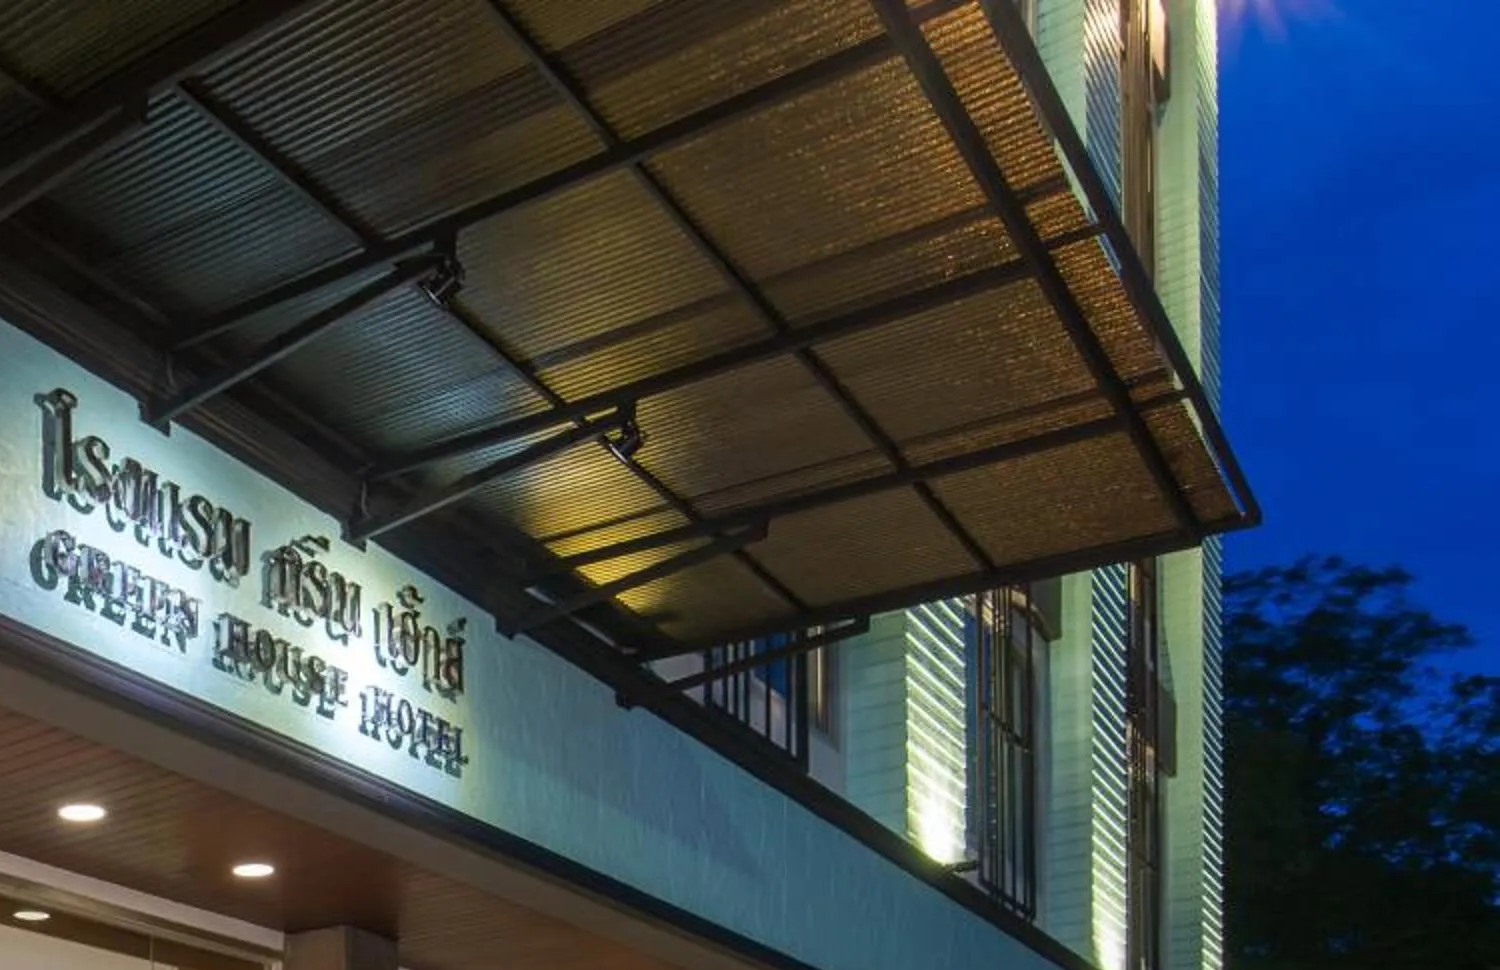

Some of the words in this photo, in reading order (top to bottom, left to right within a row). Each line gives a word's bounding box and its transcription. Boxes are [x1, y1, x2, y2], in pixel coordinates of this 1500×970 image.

[35, 388, 252, 585] โรงแรม
[32, 530, 203, 651] GREEN
[213, 612, 349, 718] HOUSE
[360, 684, 468, 776] HOTEL
